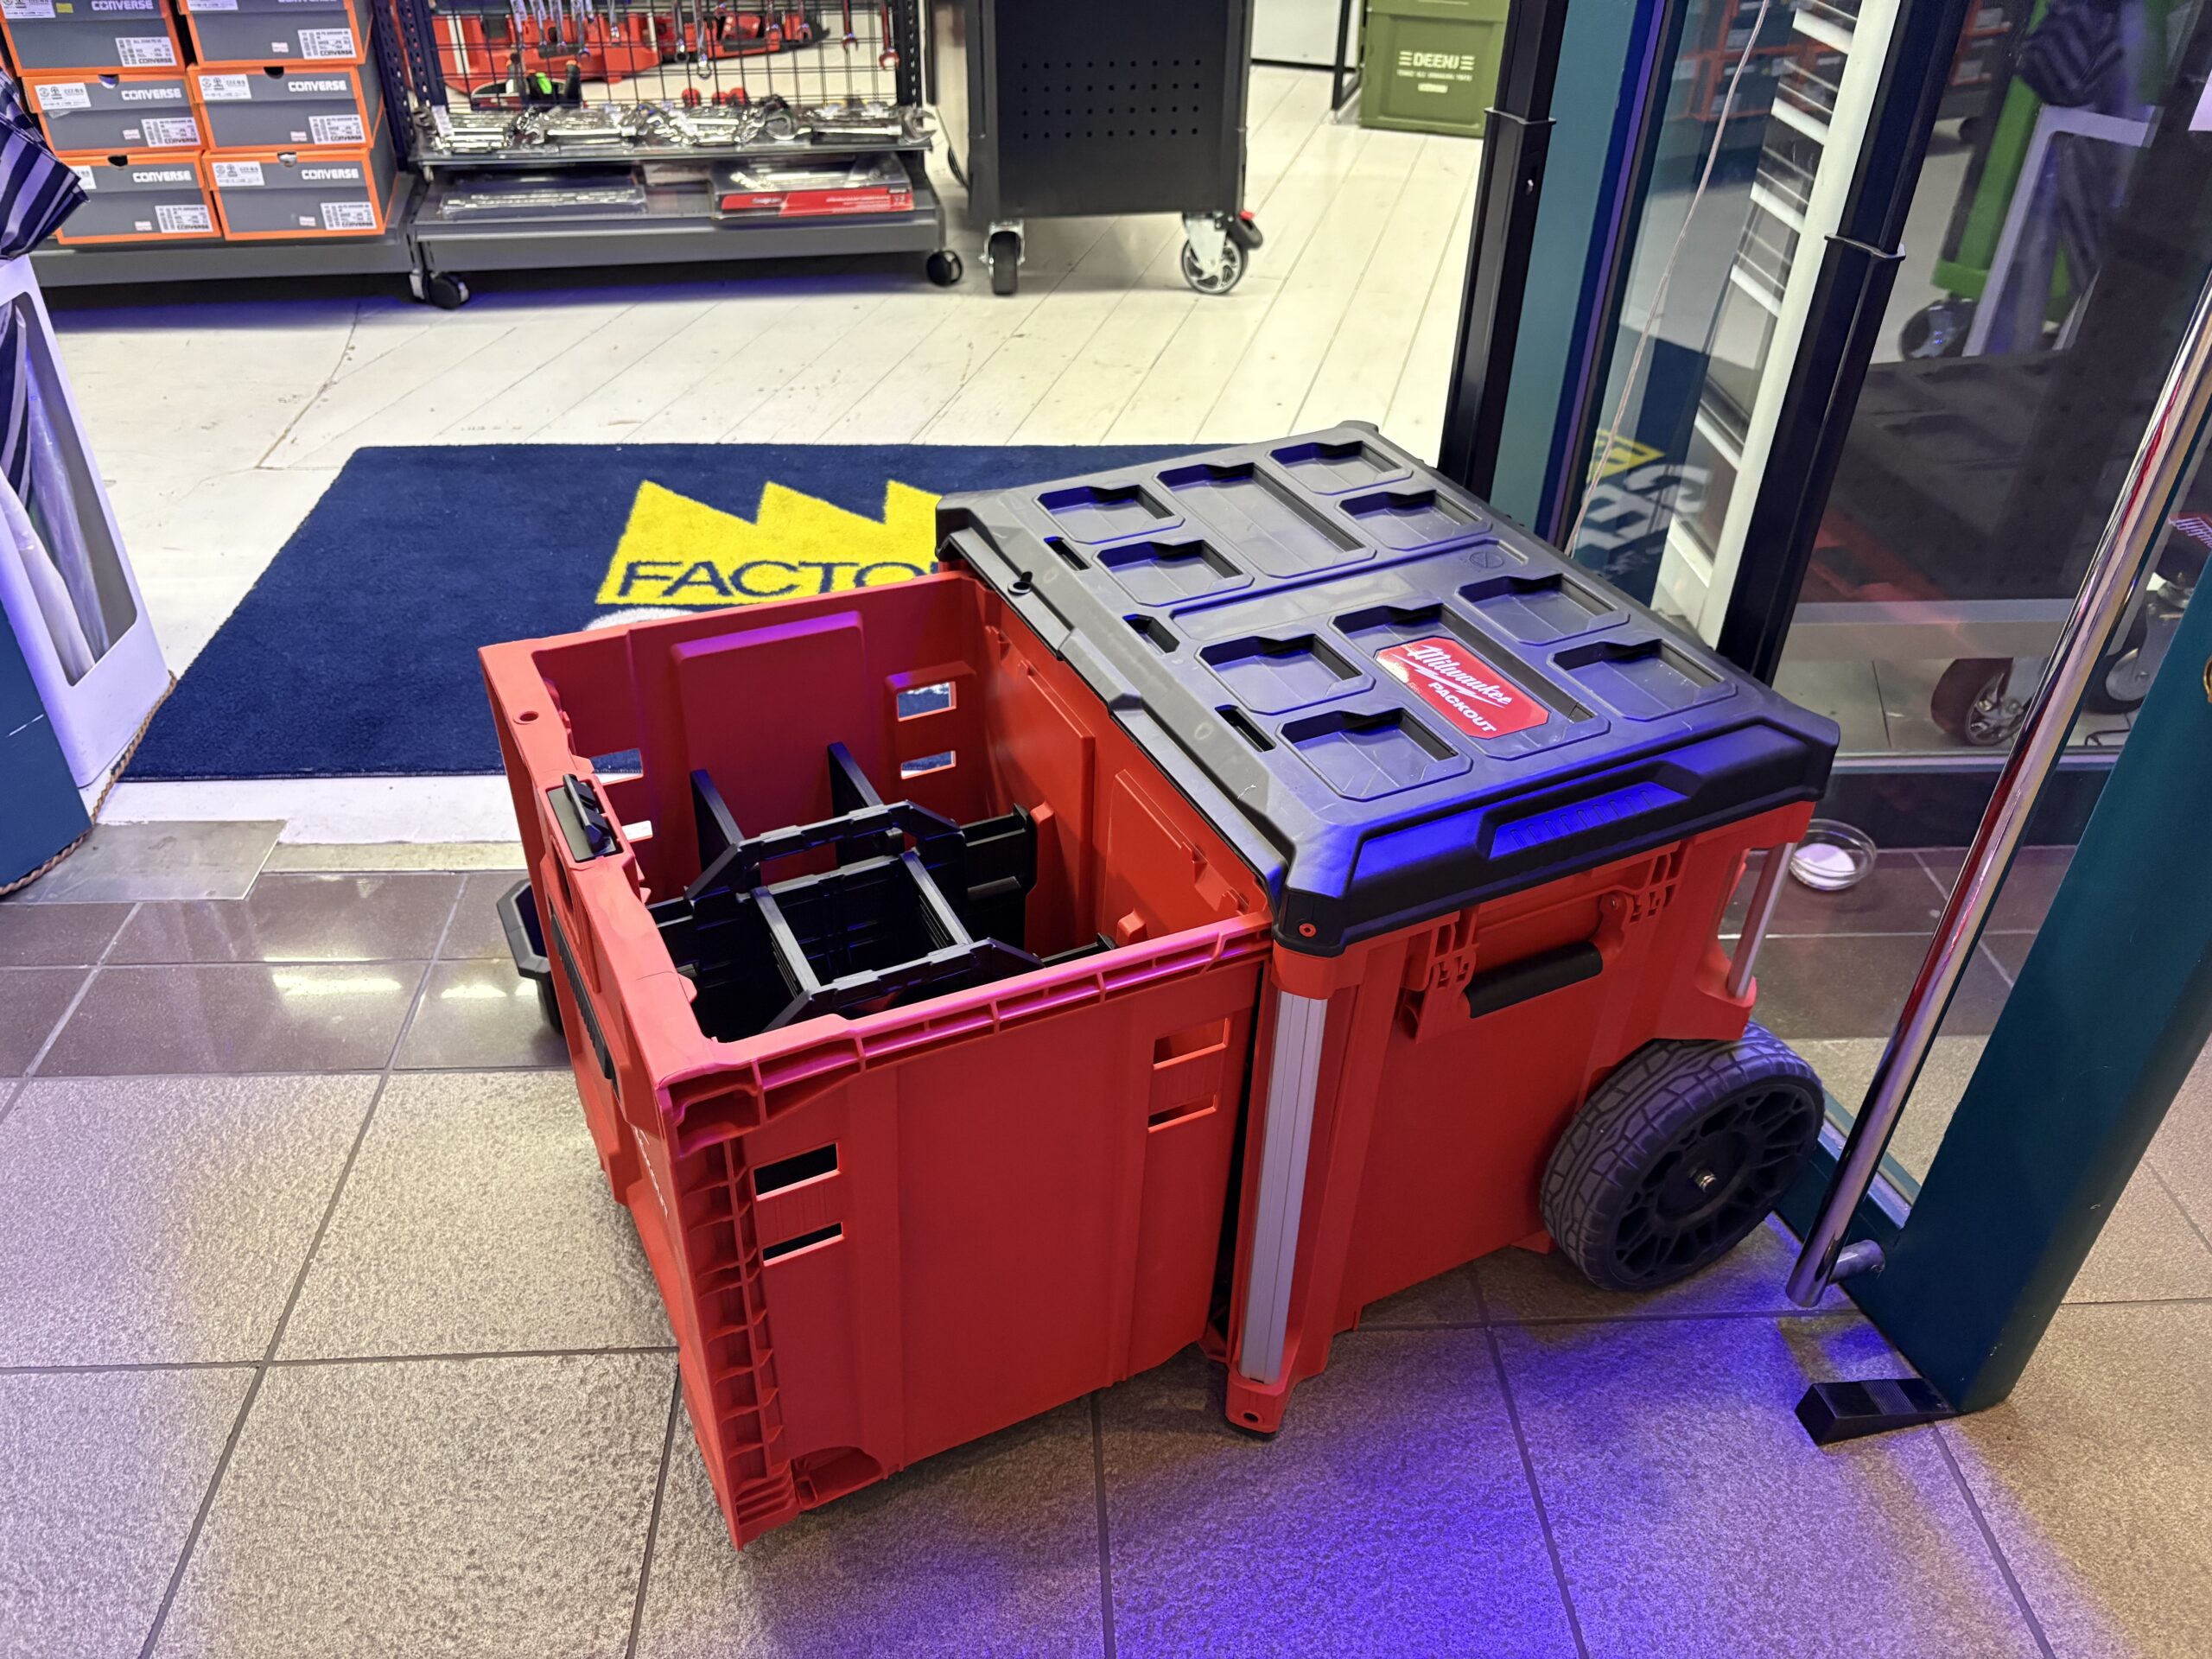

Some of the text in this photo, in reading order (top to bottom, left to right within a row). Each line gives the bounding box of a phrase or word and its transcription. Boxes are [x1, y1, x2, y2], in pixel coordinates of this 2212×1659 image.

[92, 0, 154, 10] CONVERSE
[288, 79, 347, 92] CONVERSE
[121, 87, 182, 100] CONVERSE
[132, 170, 192, 182] CONVERSE
[302, 168, 359, 180] CONVERSE
[617, 560, 938, 597] FACTO
[1402, 644, 1513, 705] Milwaukee
[1428, 682, 1497, 732] PACKOUT
